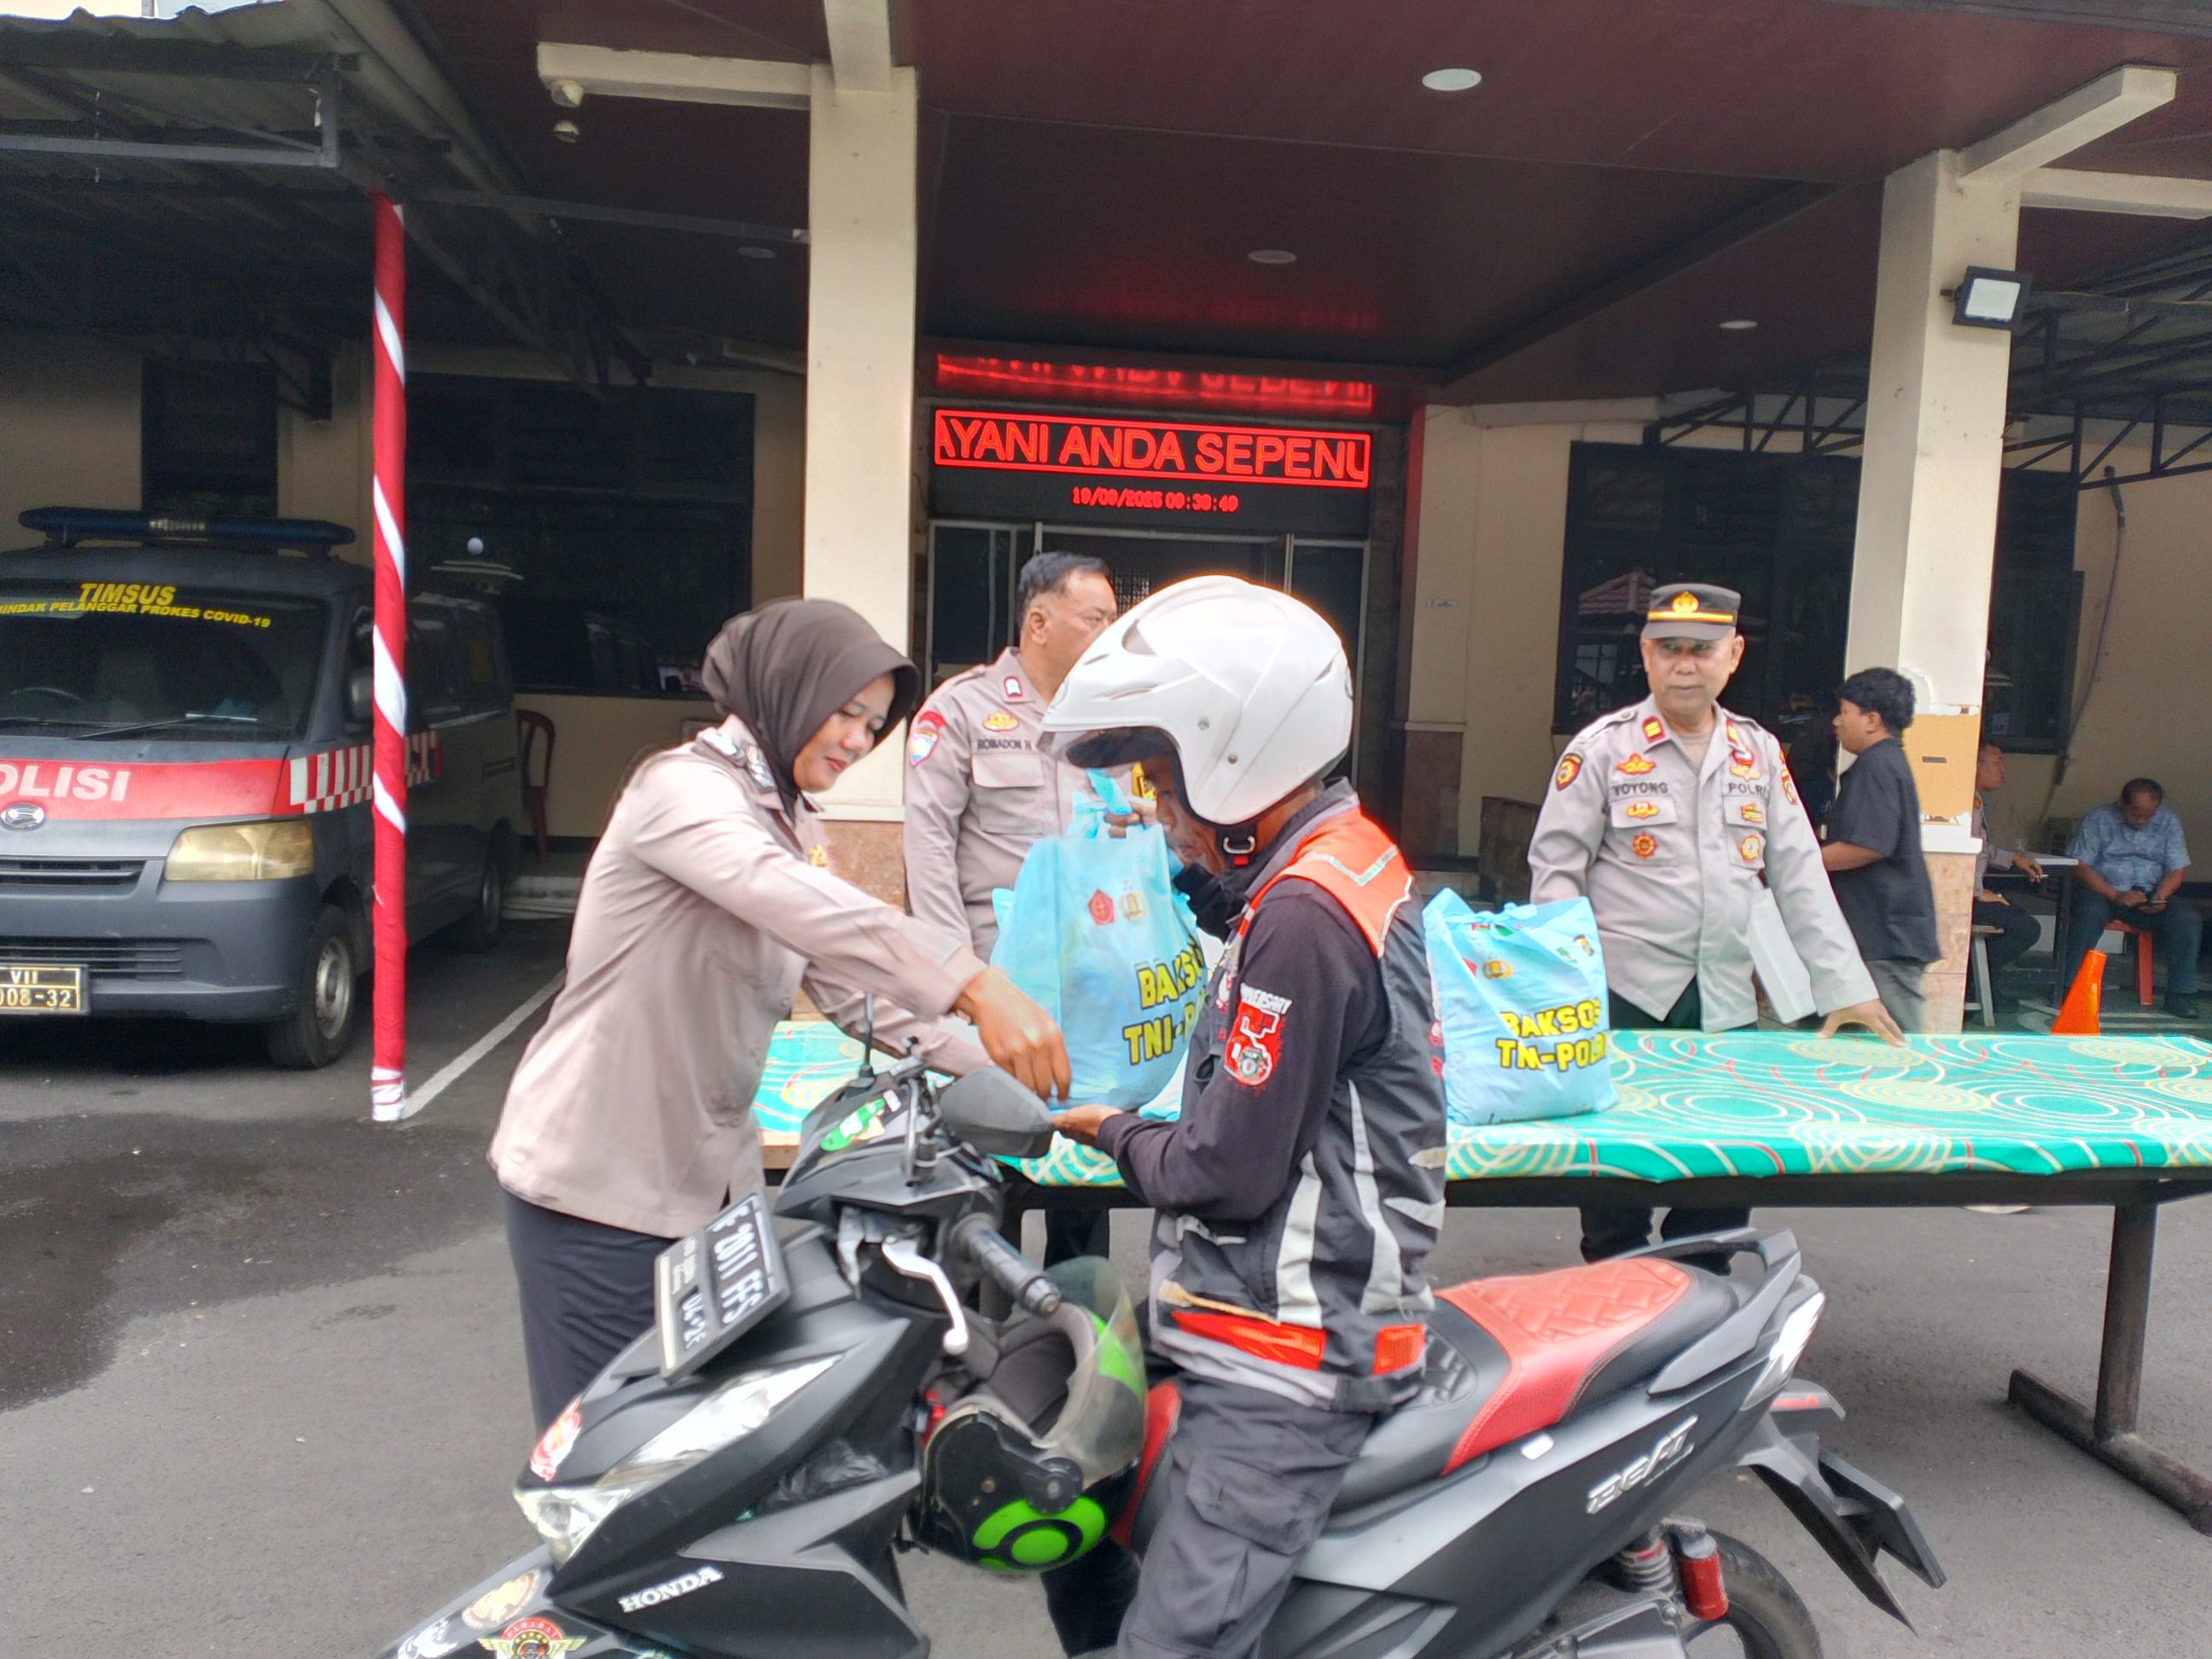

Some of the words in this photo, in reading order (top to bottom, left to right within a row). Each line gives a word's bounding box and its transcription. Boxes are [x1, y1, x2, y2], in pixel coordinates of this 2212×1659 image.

[1058, 425, 1185, 471] ANDA
[79, 583, 177, 606] TIMSUS
[0, 602, 47, 614] INDAK
[49, 601, 138, 614] PELANGGAR
[139, 604, 201, 619] PROKES
[202, 608, 271, 628] COVID-19
[9, 970, 38, 984] VII
[617, 1565, 725, 1614] HONDA
